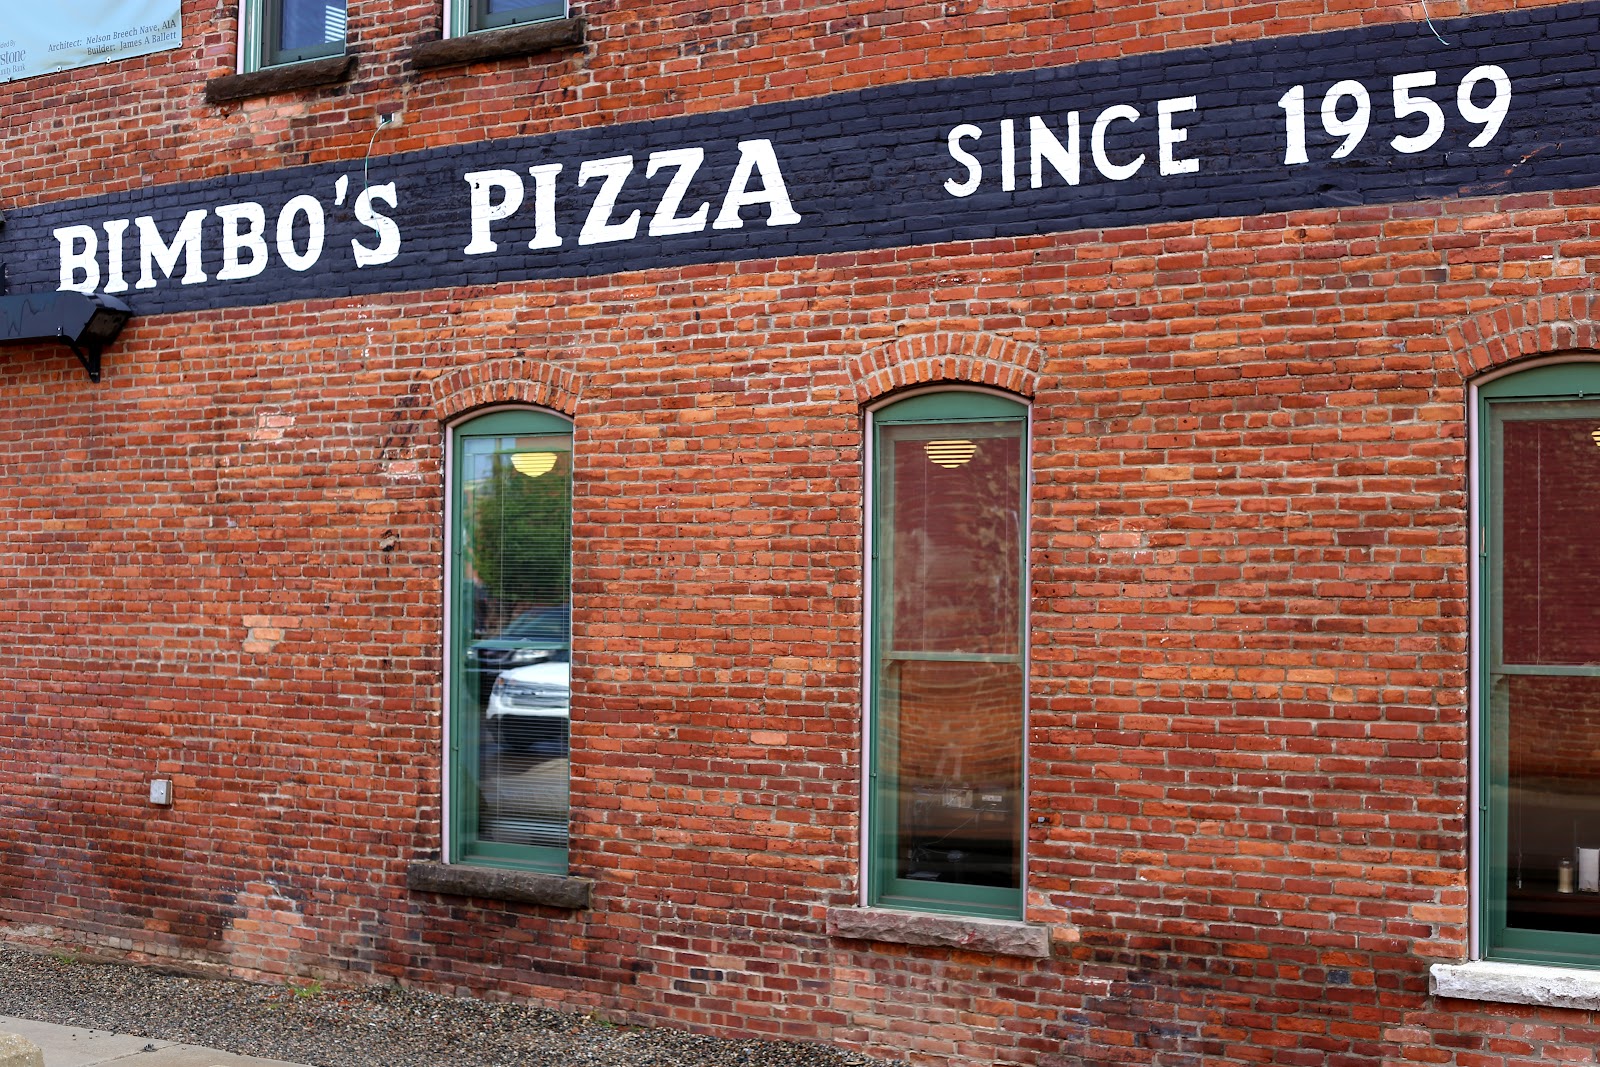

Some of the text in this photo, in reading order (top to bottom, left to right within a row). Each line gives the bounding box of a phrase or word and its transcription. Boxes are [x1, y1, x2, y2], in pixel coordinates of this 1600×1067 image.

[48, 19, 177, 52] Architect: Nelson Breech Nave, AIA
[87, 31, 177, 56] Builder: James A Ballett
[52, 64, 1512, 295] BIMBO'S PIZZA SINCE 1959
